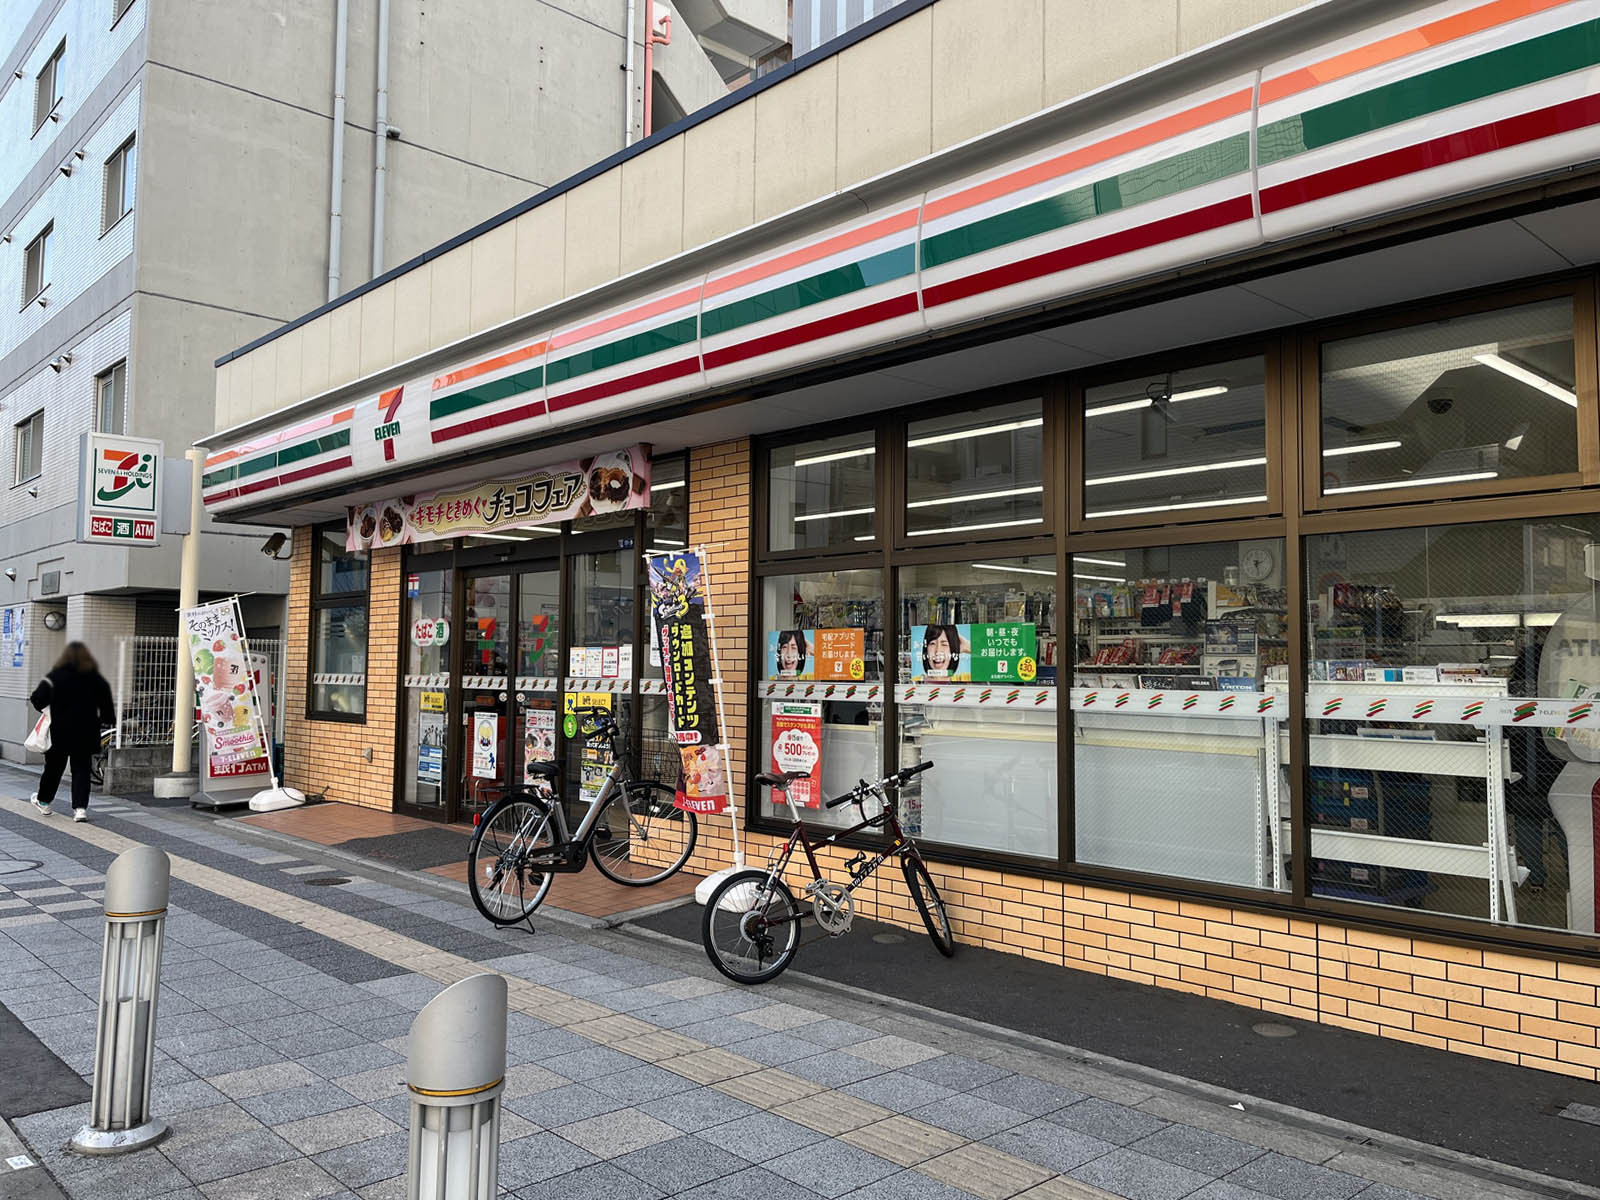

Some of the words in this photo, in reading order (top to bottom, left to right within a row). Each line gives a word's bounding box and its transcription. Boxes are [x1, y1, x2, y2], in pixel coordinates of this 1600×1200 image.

[124, 470, 152, 479] HOLDINGS
[415, 497, 482, 527] キモチときめく
[483, 472, 583, 522] チョコフェア
[92, 520, 112, 534] たばこ
[117, 522, 130, 535] 酒
[135, 523, 154, 537] ATM
[189, 613, 221, 632] そのまま
[822, 632, 856, 641] 宅配アプリで
[986, 627, 1019, 637] 朝・昼・夜
[987, 638, 1018, 647] いつでも
[822, 650, 857, 658] お届けします。
[980, 648, 1027, 657] お届けします。
[671, 622, 685, 729] ダウンロードカード
[214, 734, 255, 750] Smoothie
[784, 743, 802, 756] 500
